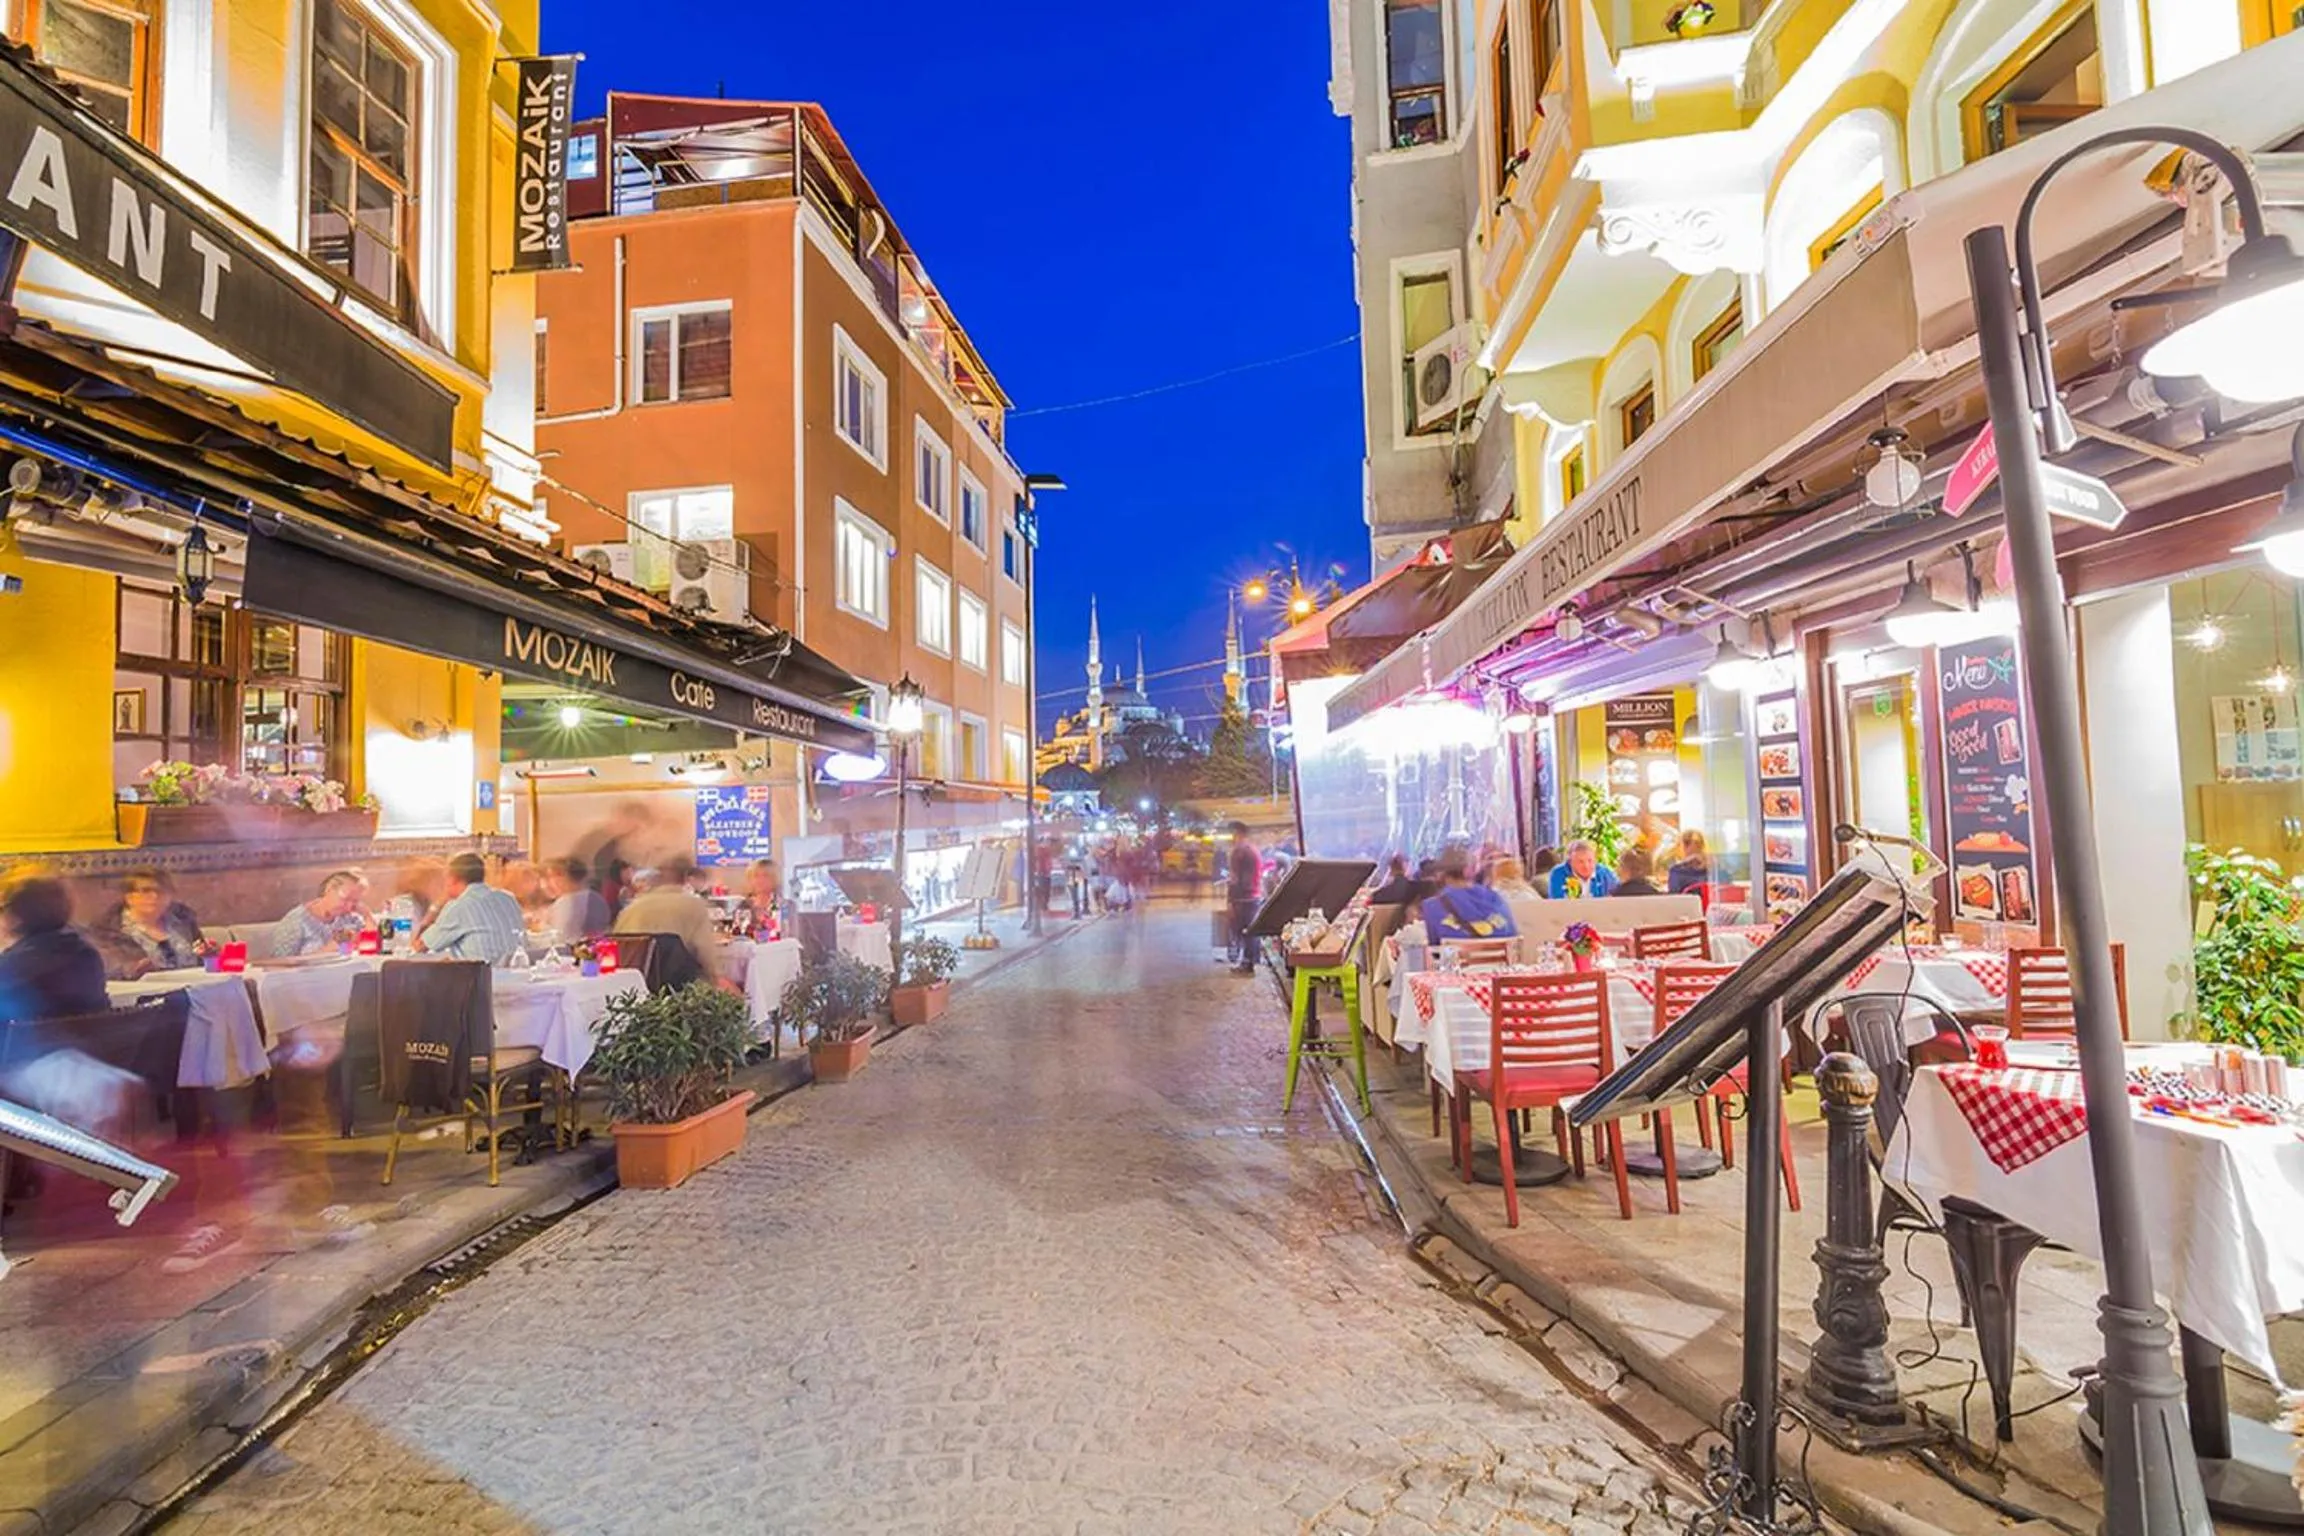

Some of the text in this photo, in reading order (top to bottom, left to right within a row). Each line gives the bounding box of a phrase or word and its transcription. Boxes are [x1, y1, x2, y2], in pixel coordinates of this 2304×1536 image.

[7, 125, 232, 321] ANT
[546, 73, 568, 249] Restaurant
[504, 617, 817, 739] MOZAIK Cafe Restaurant
[1611, 701, 1669, 714] MILLION
